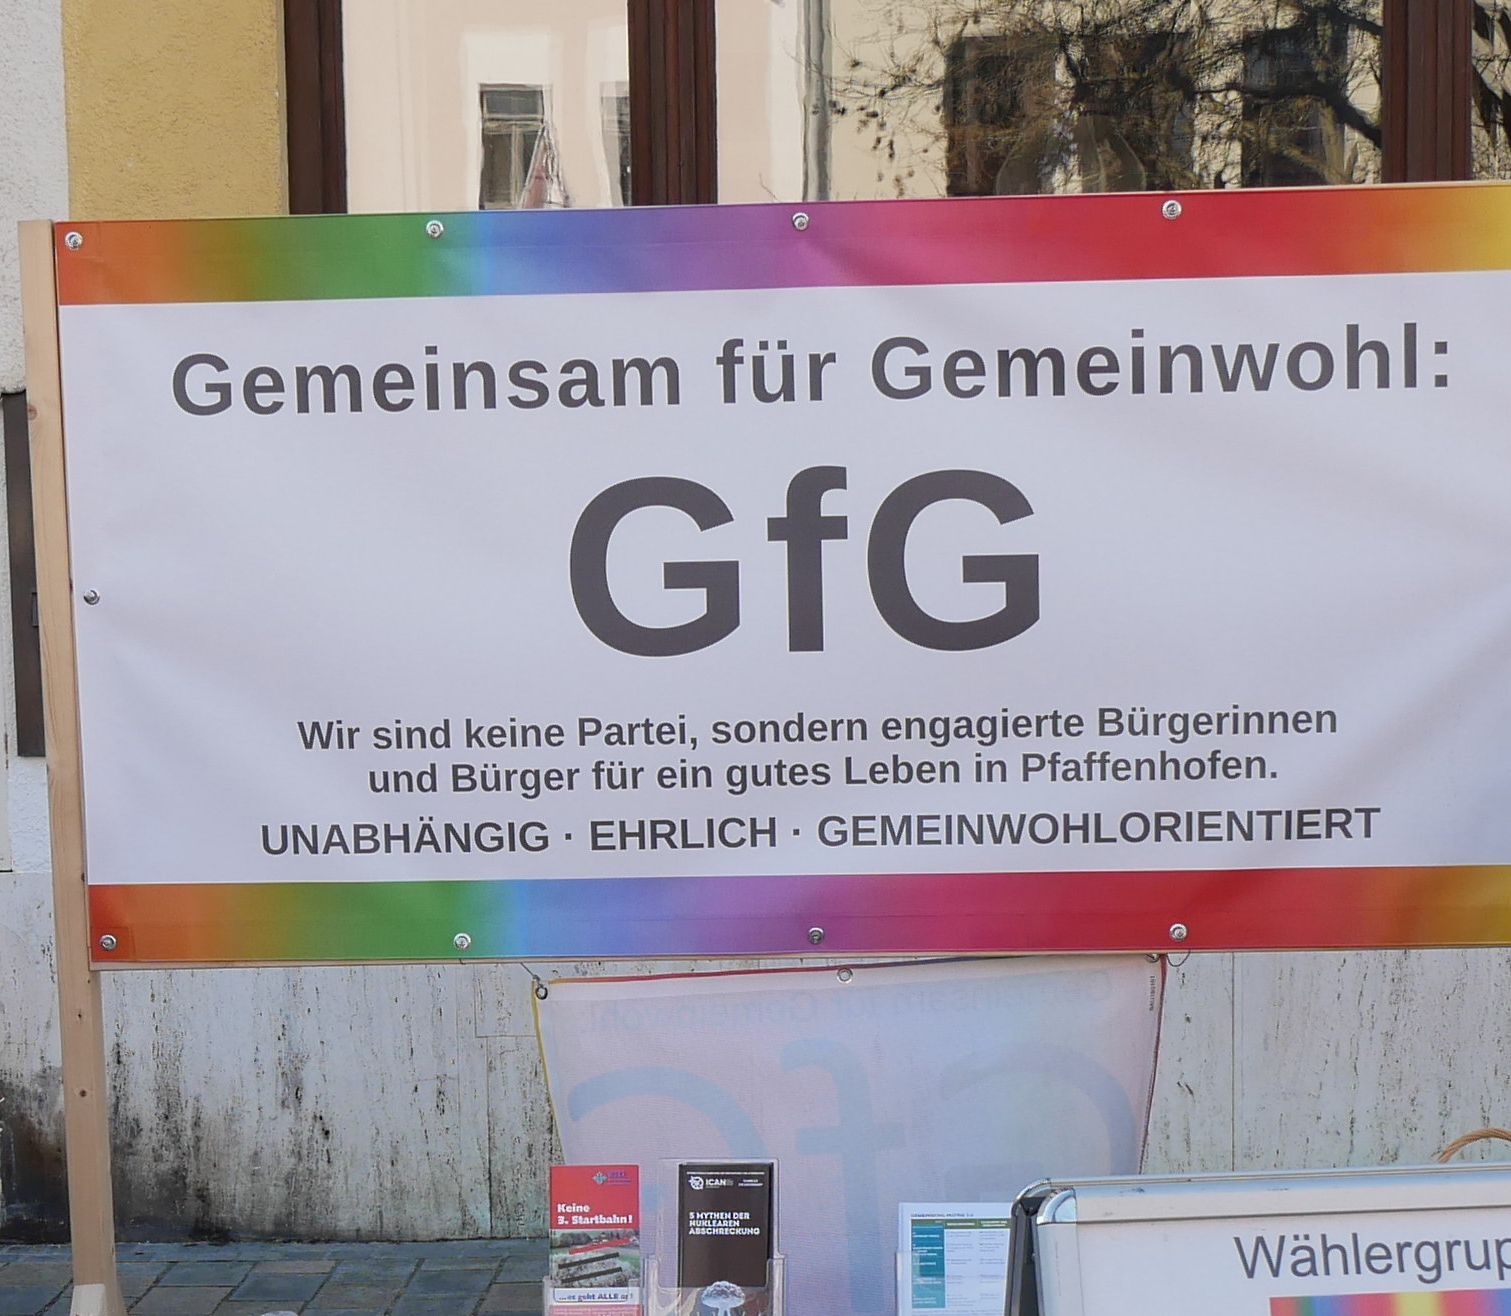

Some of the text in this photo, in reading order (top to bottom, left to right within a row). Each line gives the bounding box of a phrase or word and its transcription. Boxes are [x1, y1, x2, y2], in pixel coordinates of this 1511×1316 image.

[172, 321, 1450, 416] Gemeinsam für Gemeinwohl:
[568, 464, 1041, 658] GfG
[297, 704, 1338, 751] Wir sind keine Partei, sondern engagierte Bürgerinnen
[368, 748, 1279, 800] und Bürger für ein gutes Leben in Pfaffenhofen.
[260, 806, 1382, 856] UNABHÄNGIG EHRLICH GEMEINWOHLORIENTIERT
[705, 1178, 727, 1187] ICAN
[557, 1203, 591, 1214] Keine
[557, 1215, 633, 1225] 3. Startbahn!
[696, 1212, 731, 1220] MYTHEN
[732, 1212, 750, 1220] DER
[688, 1219, 740, 1227] NUKLEAREN
[688, 1227, 761, 1236] ABSCHRECKUNG
